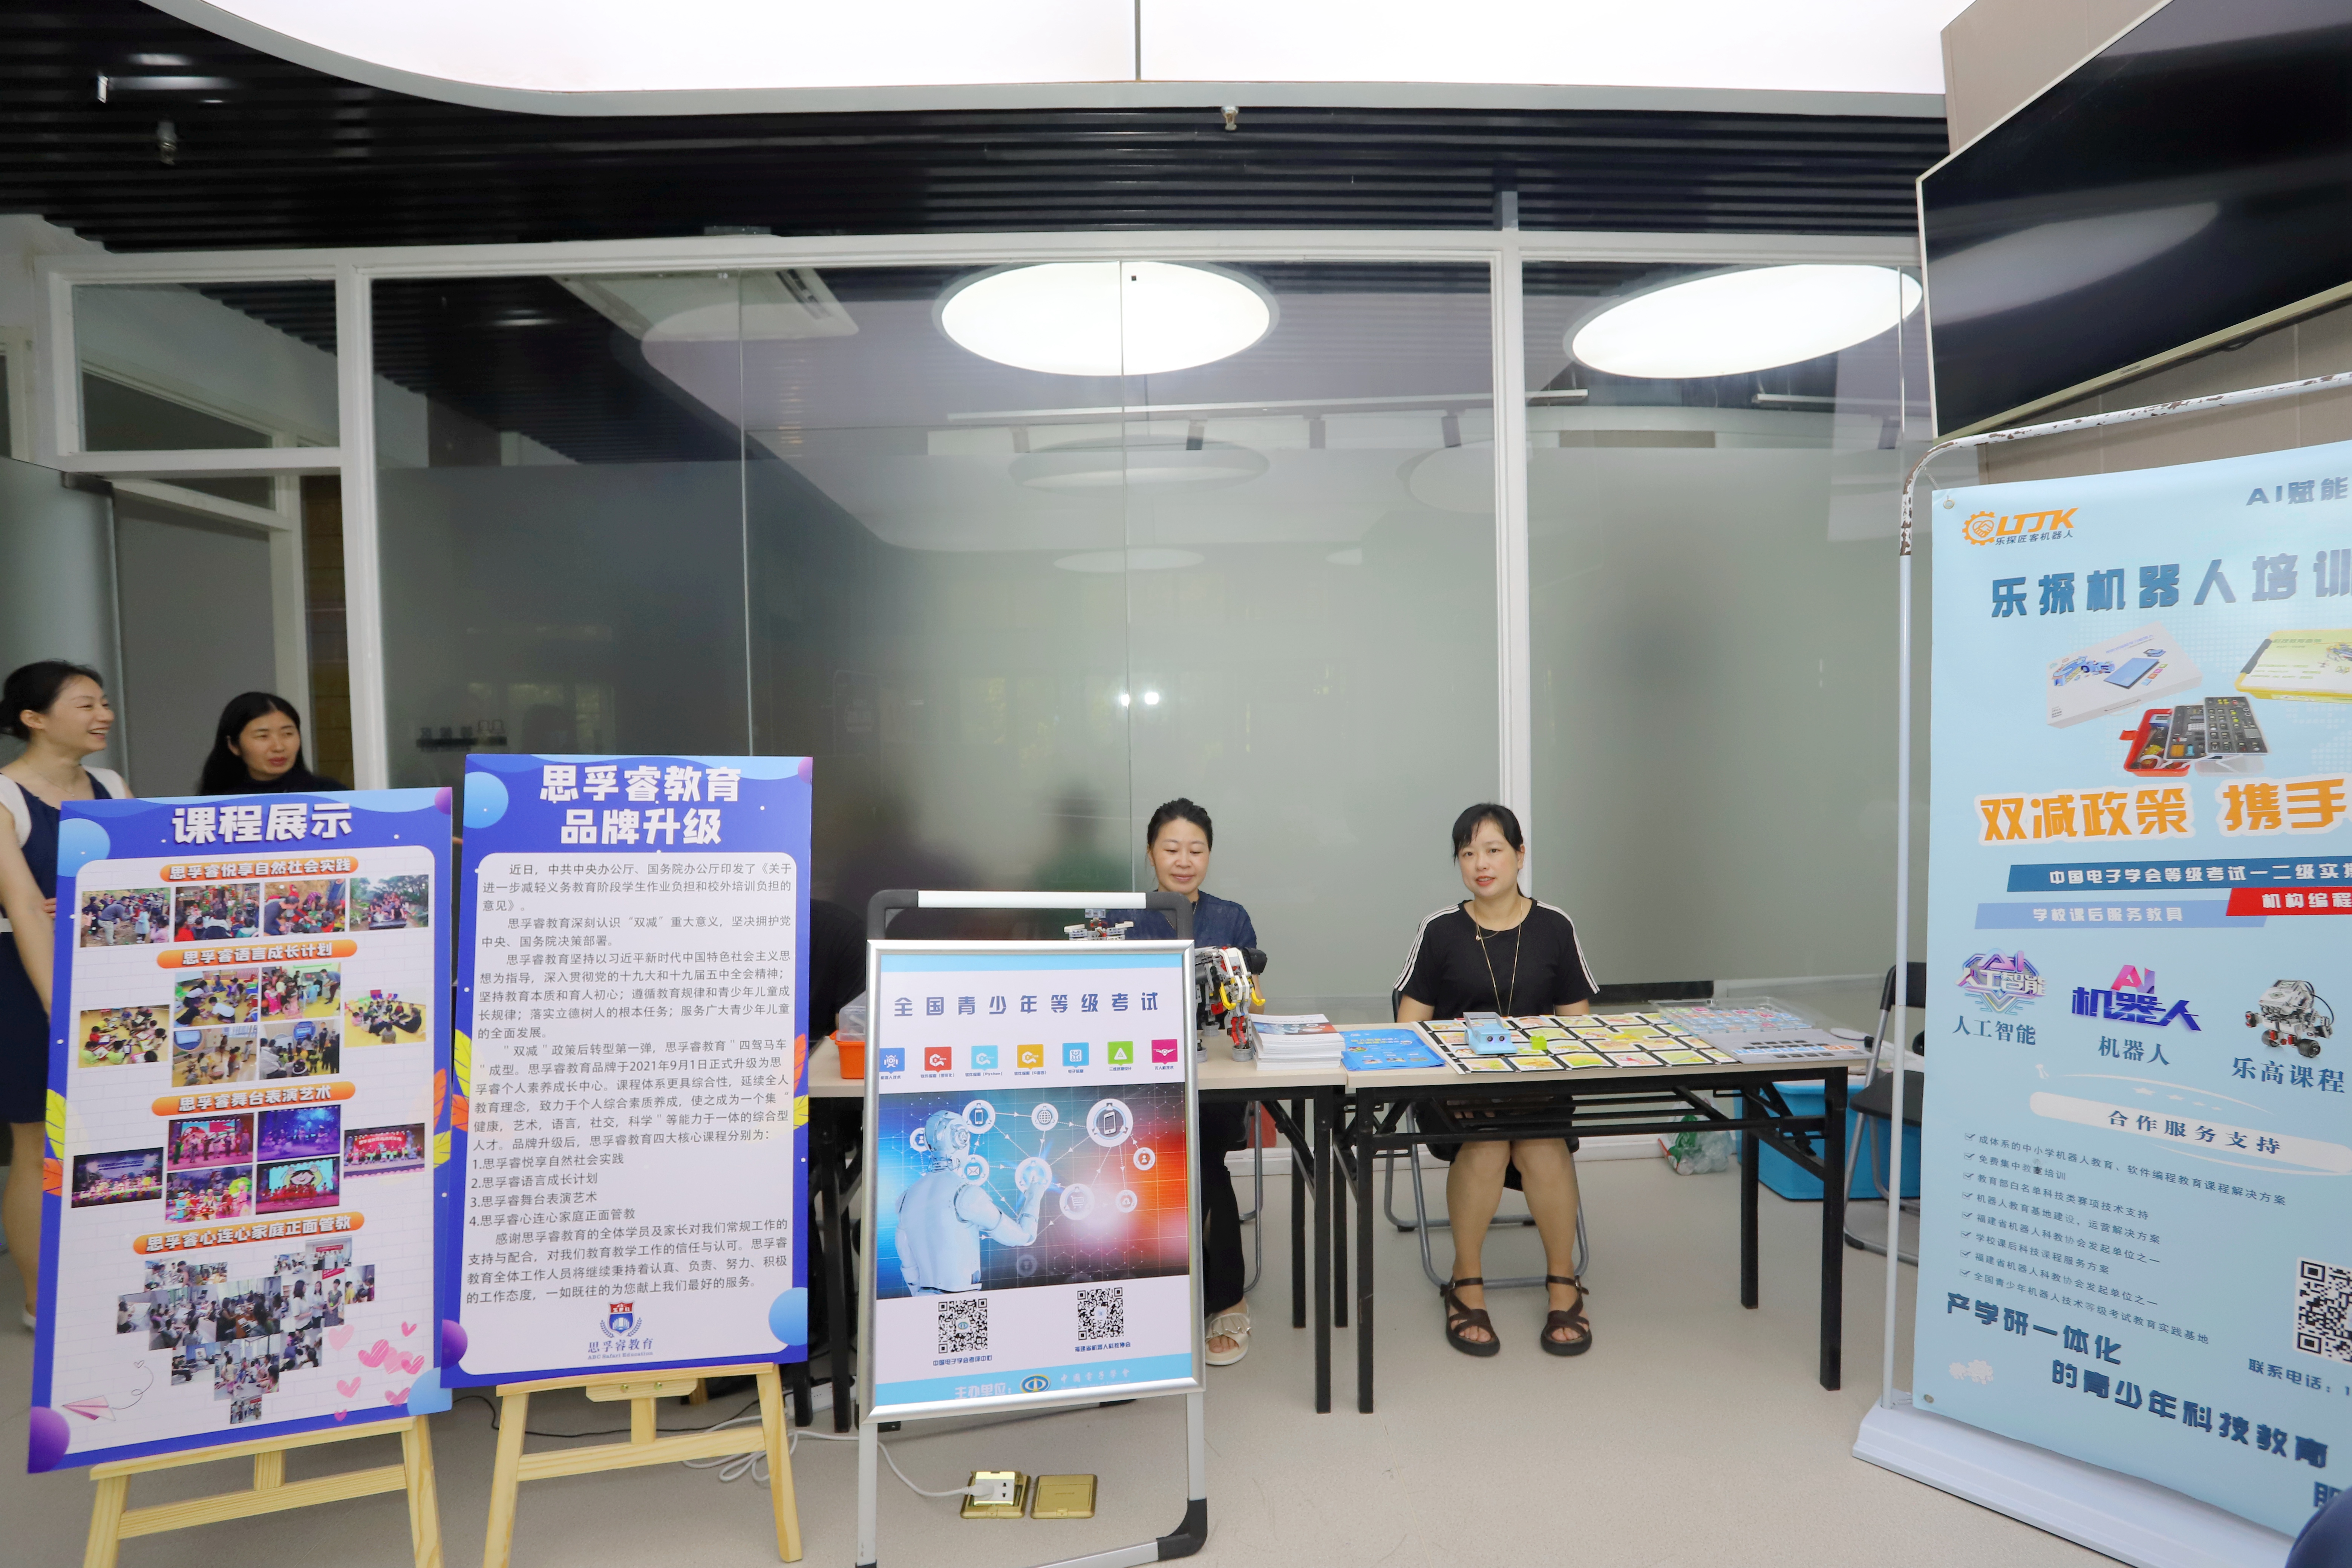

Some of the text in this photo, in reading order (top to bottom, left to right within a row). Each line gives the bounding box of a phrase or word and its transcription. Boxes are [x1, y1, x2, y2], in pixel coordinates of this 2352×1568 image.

[1995, 530, 2073, 545] 乐探匠客机器人
[1991, 548, 2352, 617] 乐探机器人培训
[539, 765, 741, 802] 思孚睿教育
[172, 803, 352, 844] 课程展示
[1980, 779, 2347, 841] 双减政策 携手
[560, 808, 722, 845] 品牌升级
[169, 858, 351, 880] 思孚睿悦享自然社会实践
[509, 863, 792, 875] 近日，中共中央办公厅、国务院办公厅印发了《关于
[483, 880, 791, 893] 进一步减轻义务教育阶段学生作业负担和校外培训负担的
[2262, 892, 2352, 908] 机构编程
[483, 900, 525, 911] 意见》。
[2034, 907, 2183, 922] 学校课后服务教具
[182, 943, 332, 965] 思孚睿语言成长计划
[482, 935, 613, 948] 中央、国务院决策部署。
[507, 951, 790, 965] 思孚睿教育坚持以习近平新时代中国特色社会主义思
[1977, 948, 2024, 973] AI
[480, 968, 783, 984] 想为指导，深入贯彻党的十九大和十九届五中全会精神；
[1954, 967, 2047, 995] 人工智能
[2110, 965, 2156, 995] AI
[479, 986, 790, 1002] 坚持教育本质和育人初心；遵循教育规律和青少年儿童成
[894, 992, 1158, 1017] 全国青少年等级考试
[478, 1003, 789, 1020] 长规律；落实立德树人的根本任务；服务广大青少年儿童
[2072, 987, 2202, 1031] 机器人
[478, 1027, 547, 1039] 的全面发展。
[1952, 1015, 2036, 1046] 人工智能
[2098, 1036, 2170, 1066] 机器人
[475, 1074, 789, 1095] 孚睿个人素养成长中心。课程体系更具综合性，延续全人
[2232, 1057, 2345, 1093] 乐高课程
[178, 1085, 331, 1112] 思孚睿舞台表演艺术
[473, 1129, 769, 1151] 人才。品牌升级后，思孚睿教育四大核心课程分别为：
[2108, 1110, 2281, 1155] 合作服务支持
[473, 1153, 624, 1170] 1.思孚睿悦享自然社会实践
[1979, 1135, 2286, 1205] 成体系的中小学机器人教育、软件编程教育课程解决方案
[471, 1172, 598, 1189] 2.思孚睿语言成长计划
[470, 1191, 597, 1207] 3.思孚睿舞台表演艺术
[1978, 1174, 2148, 1220] 教育部白名单科技类赛项技术支持
[469, 1208, 635, 1227] 4.思孚睿心连心家庭正面管教
[1977, 1194, 2160, 1244] 机器人教育基地建设，运营解决方案
[146, 1215, 351, 1252] 思孚睿心连心家庭正面管教
[496, 1218, 787, 1245] 感谢思孚睿教育的全体学员及家长对我们常规工作的
[1977, 1214, 2160, 1263] 福建省机器人科教协会发起单位之一
[468, 1237, 787, 1265] 支持与配合，对我们教育教学工作的信任与认可。思孚睿
[1976, 1233, 2109, 1275] 学校课后科技课程服务方案
[467, 1255, 787, 1285] 教育全体工作人员将继续秉持着认真、负责、努力、积极
[1975, 1253, 2158, 1305] 福建省机器人科教协会发起单位之一
[466, 1276, 755, 1304] 的工作态度，一如既往的为您献上我们最好的服务。
[1974, 1272, 2209, 1344] 全国青少年机器人技术等级考试教育实践基地
[1948, 1292, 2122, 1365] 产学研一体化
[588, 1338, 653, 1353] 思孚睿教育
[1075, 1341, 1131, 1353] 福建省机器人科教协会
[933, 1355, 992, 1366] 中国电子学会考评中心
[2052, 1359, 2328, 1468] 的青少年科技教育
